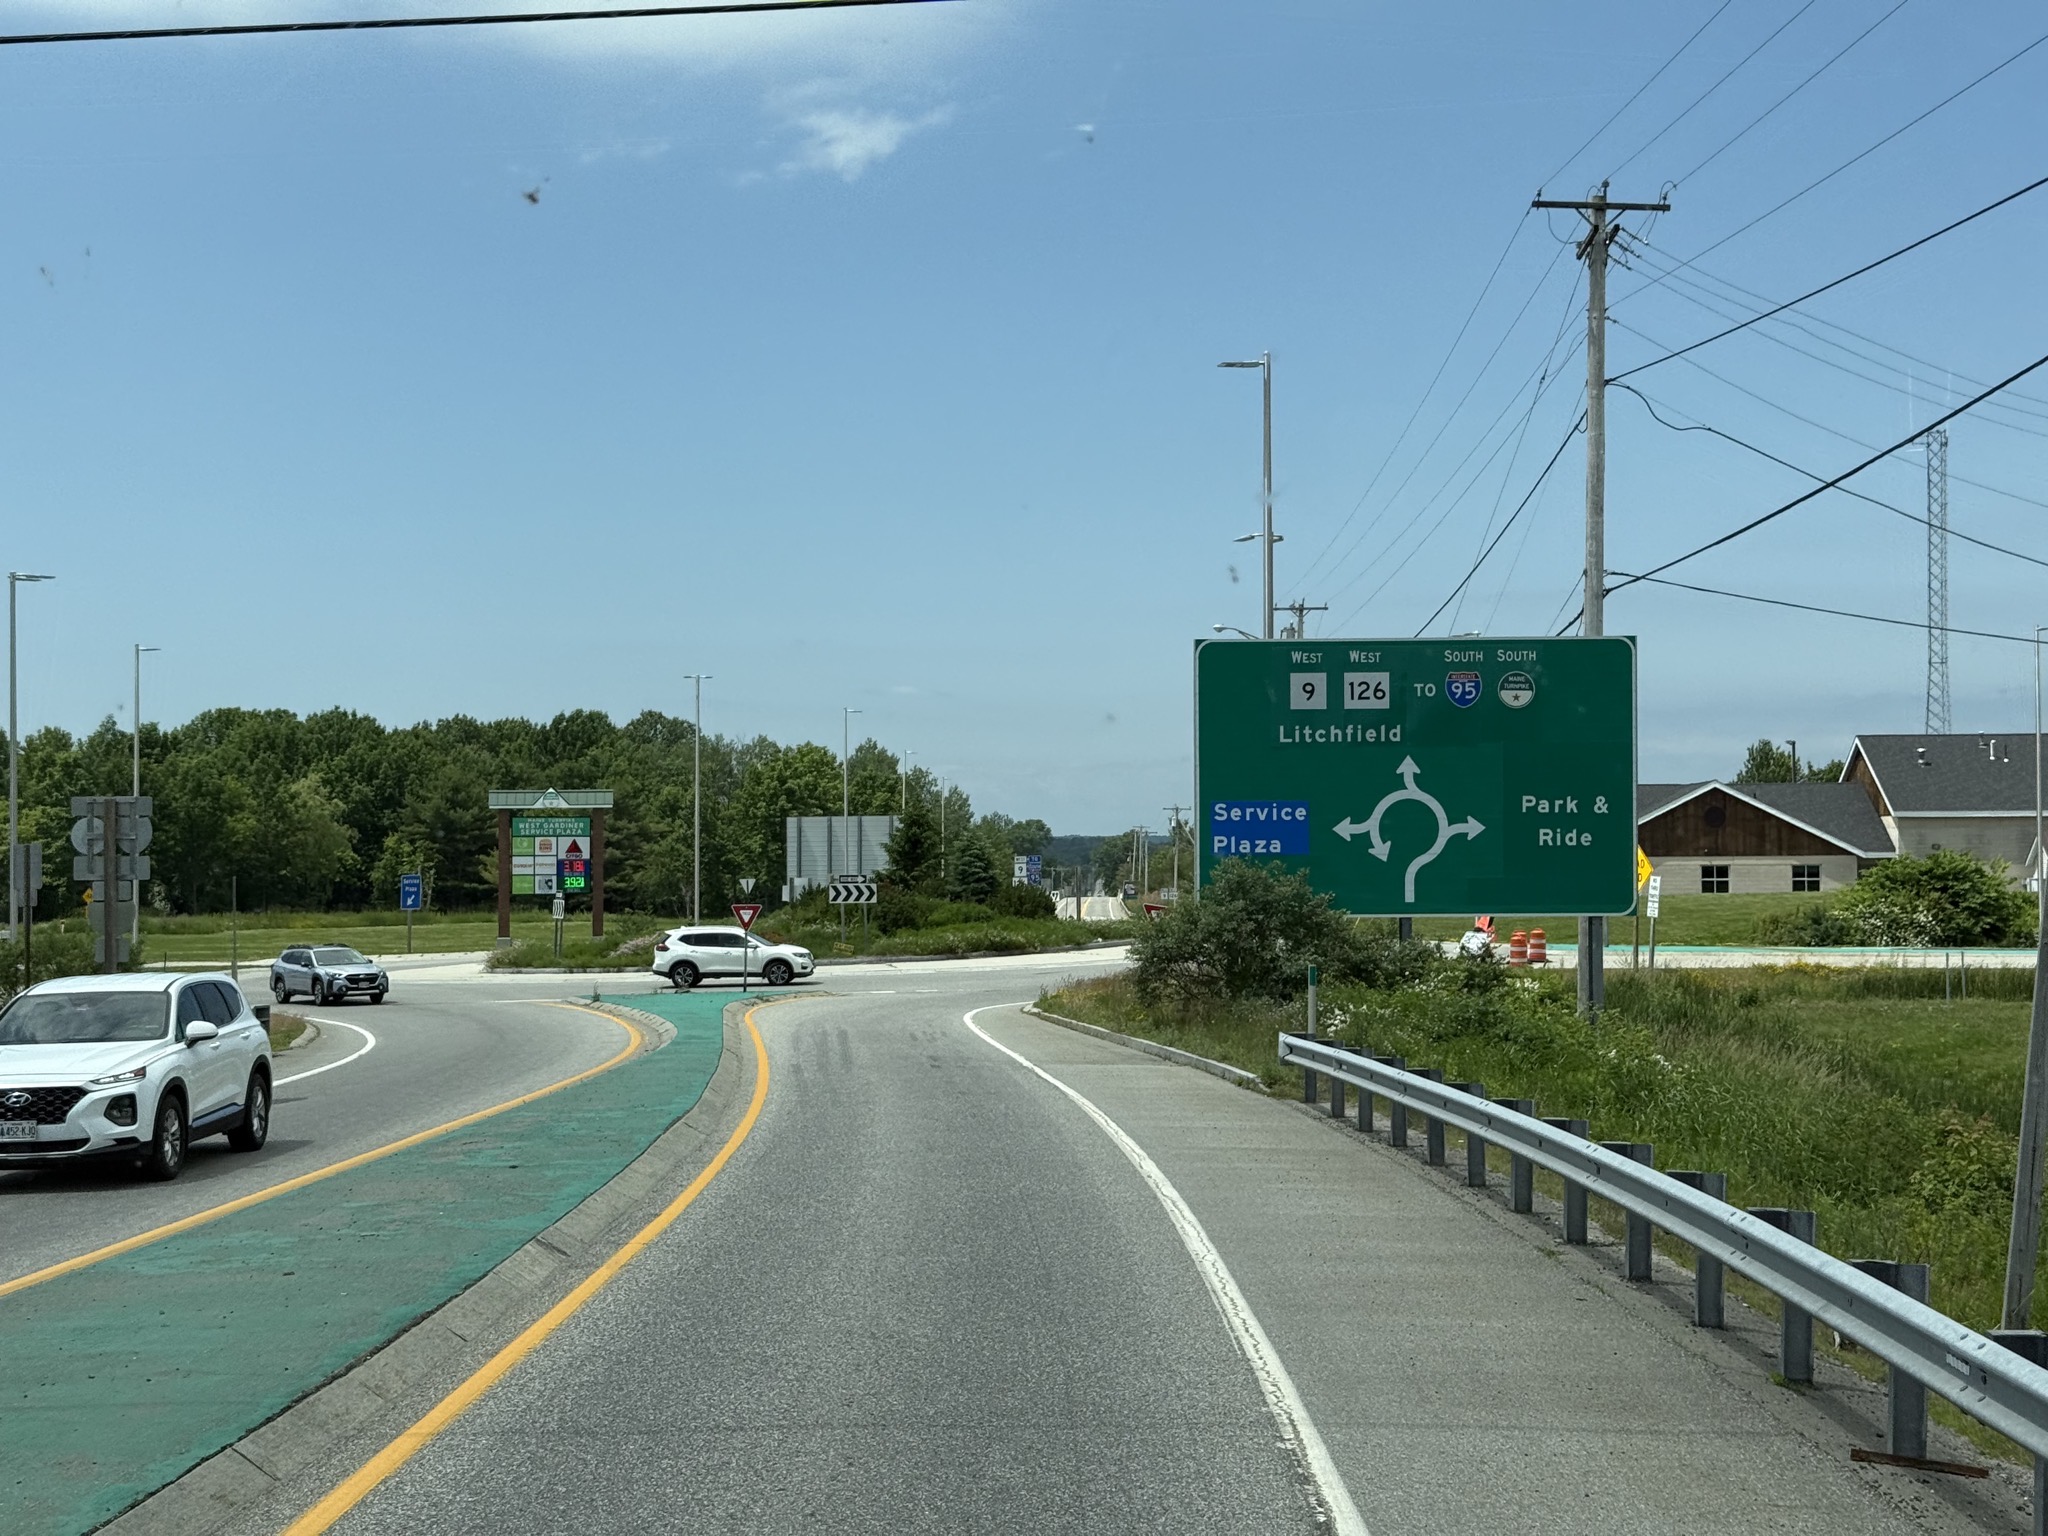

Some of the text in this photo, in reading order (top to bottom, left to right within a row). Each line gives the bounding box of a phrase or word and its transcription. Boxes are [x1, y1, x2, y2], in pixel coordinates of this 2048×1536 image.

[1291, 650, 1323, 663] WEST
[1349, 650, 1381, 663] WEST
[1444, 650, 1483, 662] SOUTH
[1496, 649, 1537, 661] SOUTH
[1302, 682, 1315, 701] 9
[1349, 680, 1386, 701] 126
[1413, 683, 1436, 697] TO
[1451, 682, 1476, 699] 95
[1279, 724, 1401, 743] Litchfield
[1213, 803, 1307, 821] Service
[1522, 795, 1609, 814] Park &
[1213, 835, 1281, 853] Plaza
[1539, 828, 1592, 846] Ride
